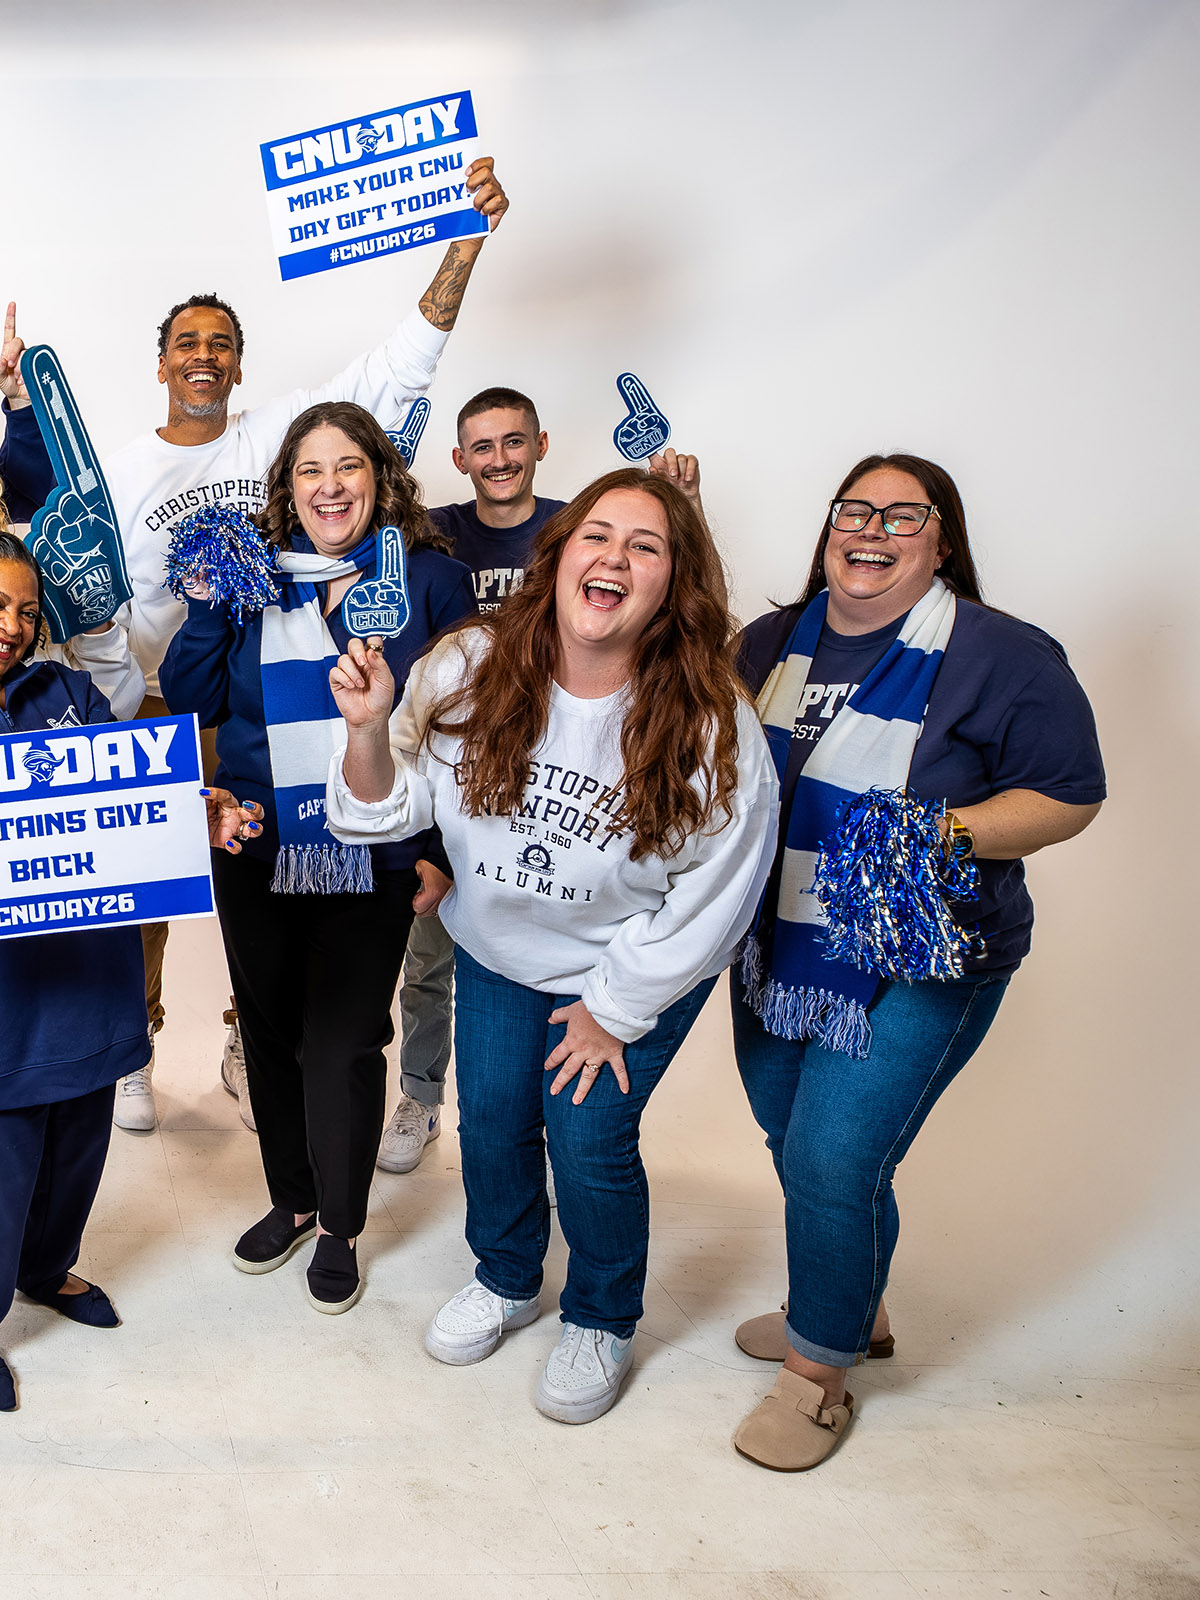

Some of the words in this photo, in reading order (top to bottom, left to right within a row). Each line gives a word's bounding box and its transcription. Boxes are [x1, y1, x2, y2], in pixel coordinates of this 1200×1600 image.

[270, 123, 363, 180] CNU
[370, 97, 462, 156] DAY
[287, 182, 350, 212] MAKE
[354, 169, 414, 195] YOUR
[418, 151, 463, 178] CNU
[288, 217, 331, 243] DAY
[336, 203, 386, 230] GIFT
[329, 222, 436, 264] #CNUDAY26
[70, 567, 111, 601] CNU
[351, 610, 399, 631] CNU
[44, 724, 179, 787] DAY
[94, 800, 168, 829] GIVE
[509, 821, 538, 837] EST.
[544, 830, 572, 850] 1960
[8, 851, 96, 883] BACK
[475, 861, 593, 902] ALUMNI
